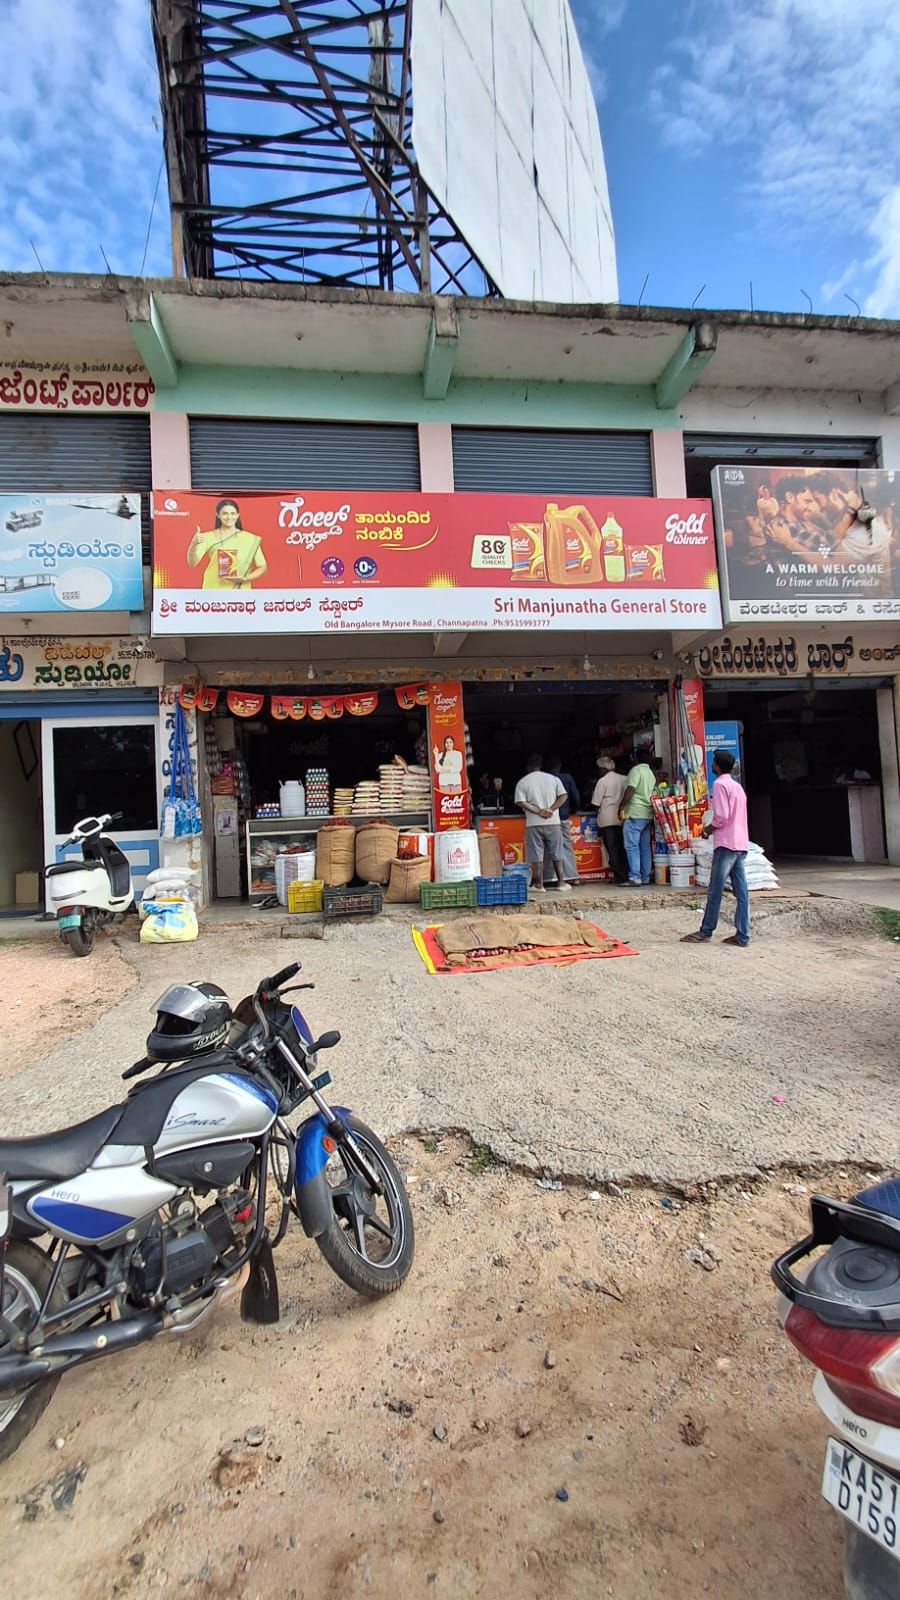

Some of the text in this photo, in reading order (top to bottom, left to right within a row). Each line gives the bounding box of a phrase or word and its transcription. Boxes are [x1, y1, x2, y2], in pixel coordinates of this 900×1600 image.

[278, 497, 431, 535] ಗೋಲ್ಡ್ ತಾಯಂದಿರ
[355, 527, 404, 541] ನಂಬಿಕೆ
[664, 513, 707, 543] Gold
[765, 564, 885, 574] A WARM WELCOME
[775, 576, 880, 588] to time with friends
[160, 597, 364, 618] ಶ್ರೀ ಮಂಜುನಾಥ ಜನರಲ್ ಸ್ಟೋರ್
[494, 598, 707, 617] Sri Manjunatha General Store
[815, 602, 847, 615] ಬಾರ್
[856, 604, 866, 614] &
[325, 621, 338, 629] Old
[340, 620, 380, 631] Bangalore
[382, 620, 410, 630] Mysore
[412, 619, 432, 628] Road
[437, 619, 488, 629] Channapatna
[807, 636, 854, 672] ಬಾರ್
[441, 794, 465, 814] Gold
[51, 1189, 81, 1202] Hero
[842, 1418, 868, 1438] Hero
[841, 1449, 898, 1514] KA51
